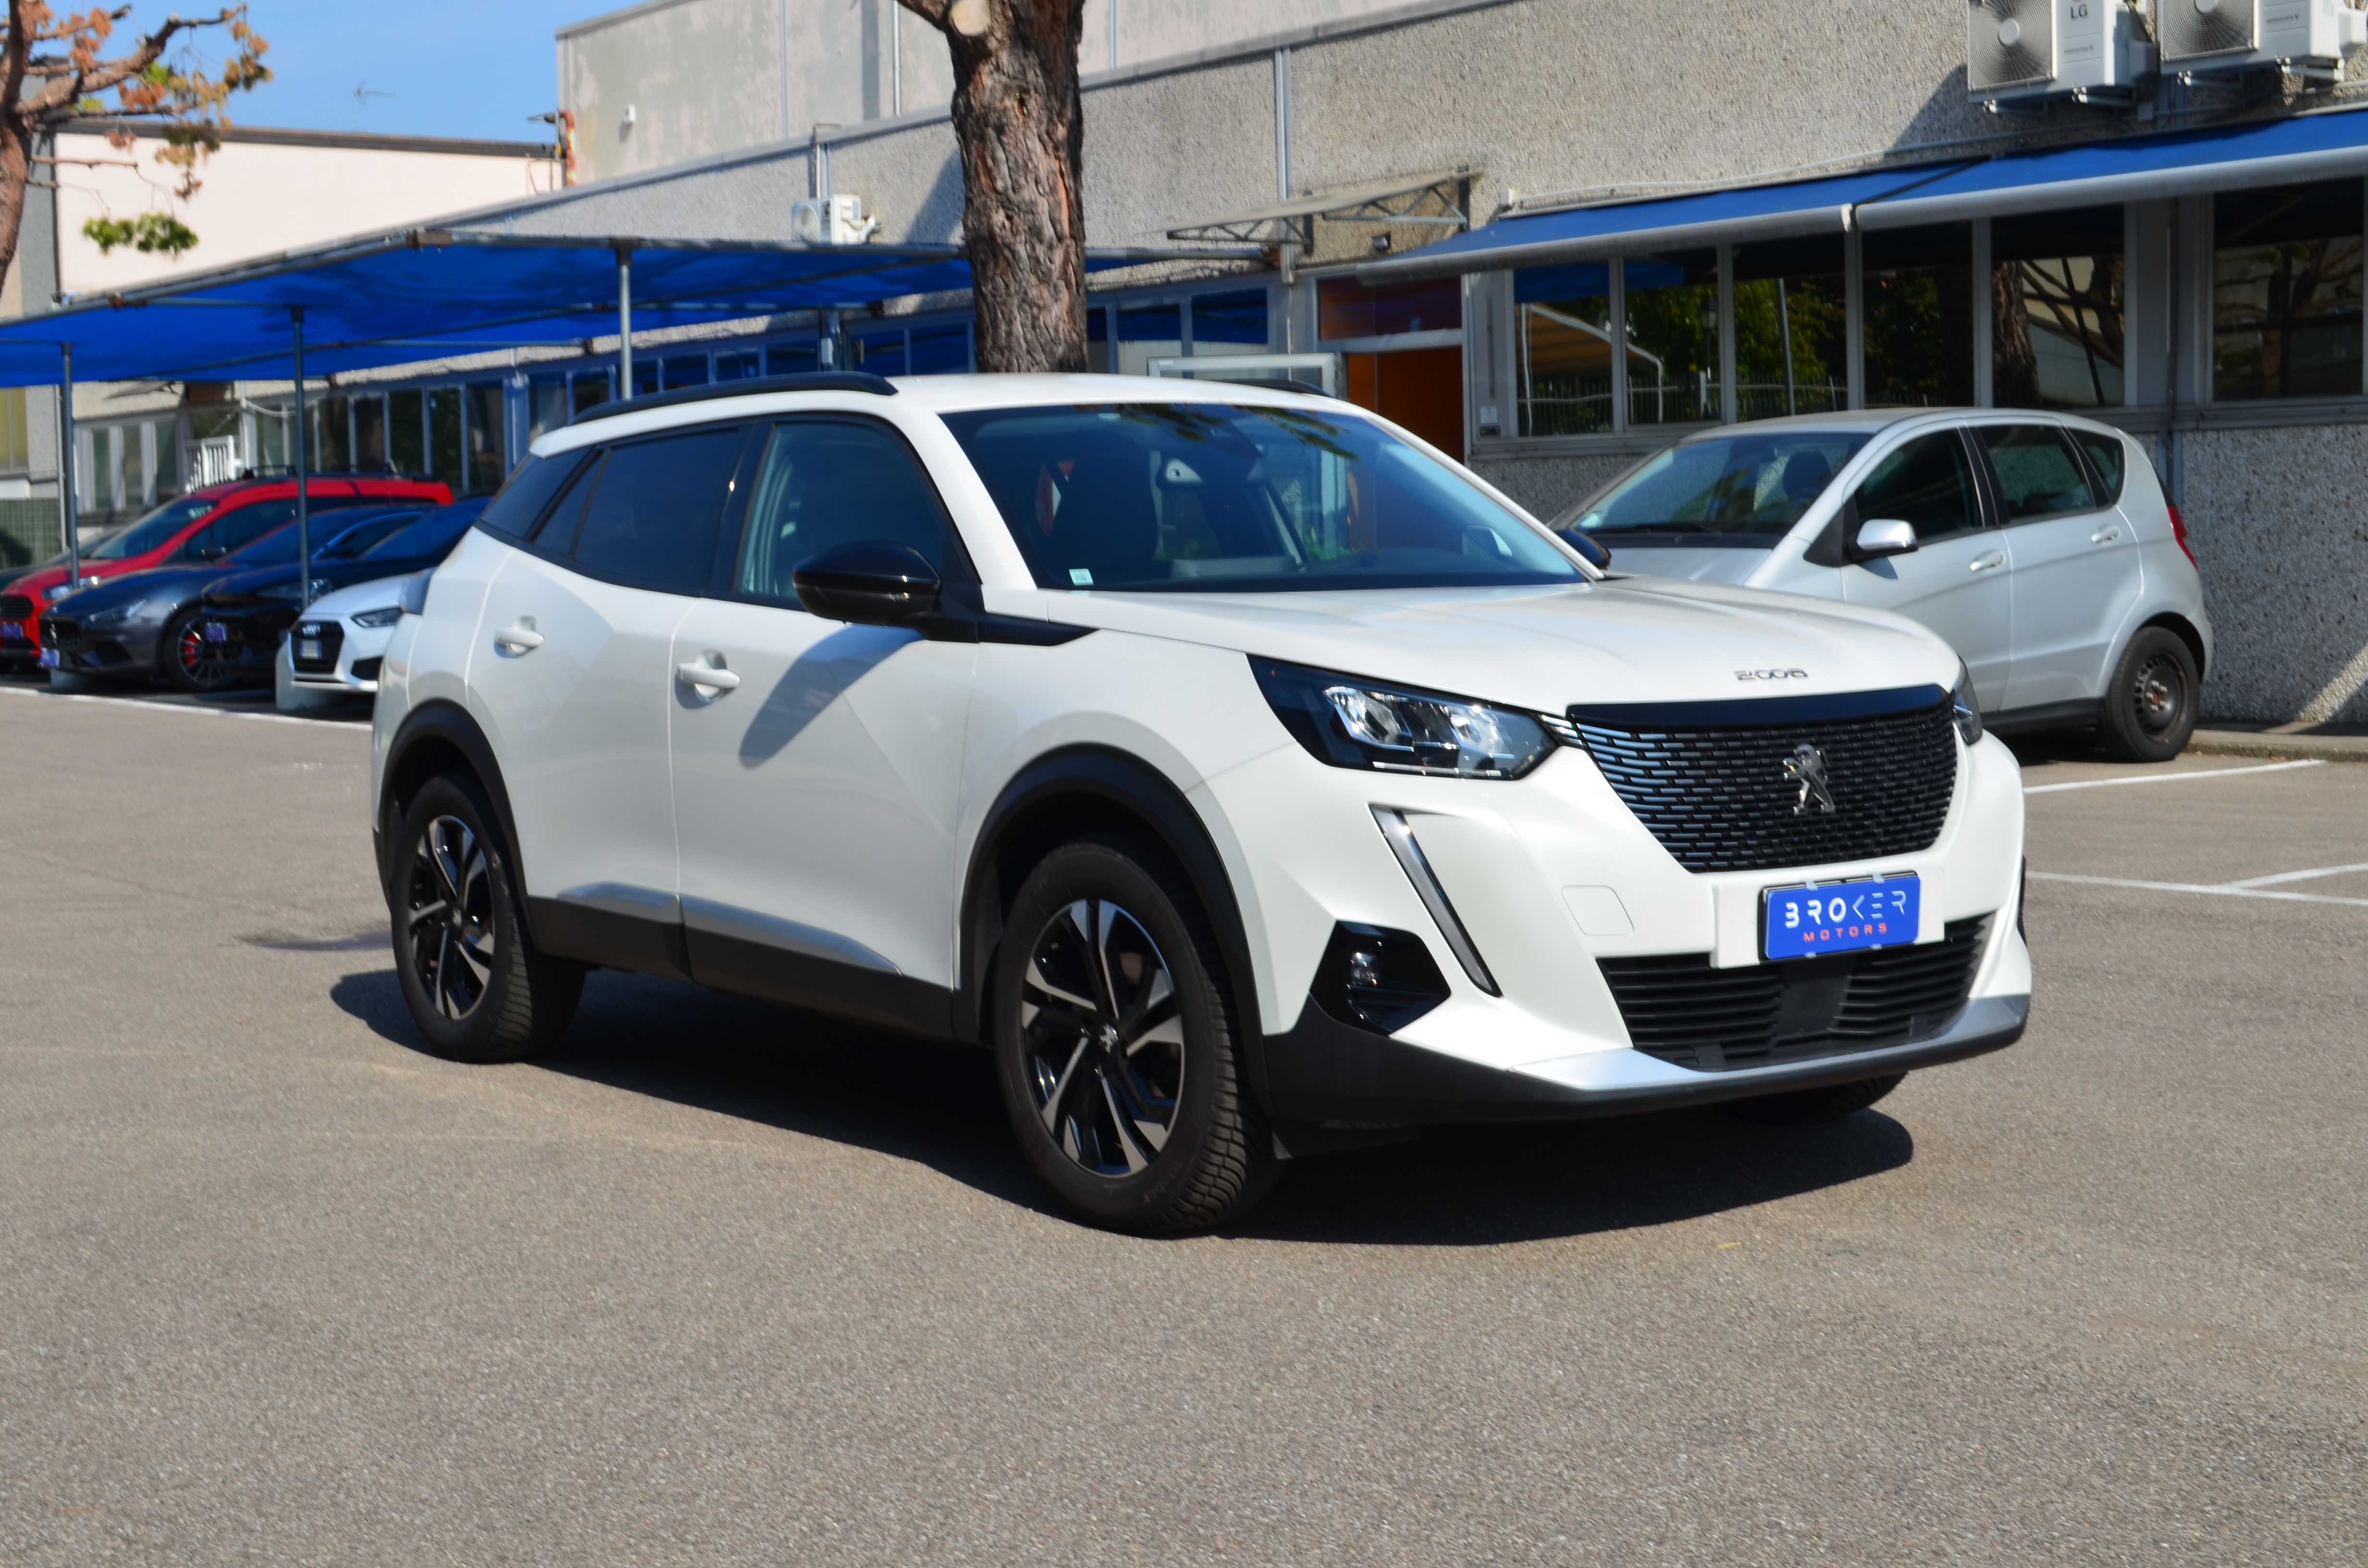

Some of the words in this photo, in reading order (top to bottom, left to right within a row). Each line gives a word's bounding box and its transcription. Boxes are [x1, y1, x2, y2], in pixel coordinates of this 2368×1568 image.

[2070, 3, 2088, 20] LG
[1734, 668, 1809, 681] 2008
[1785, 890, 1907, 929] BROKER
[1803, 922, 1887, 943] MOTORS
